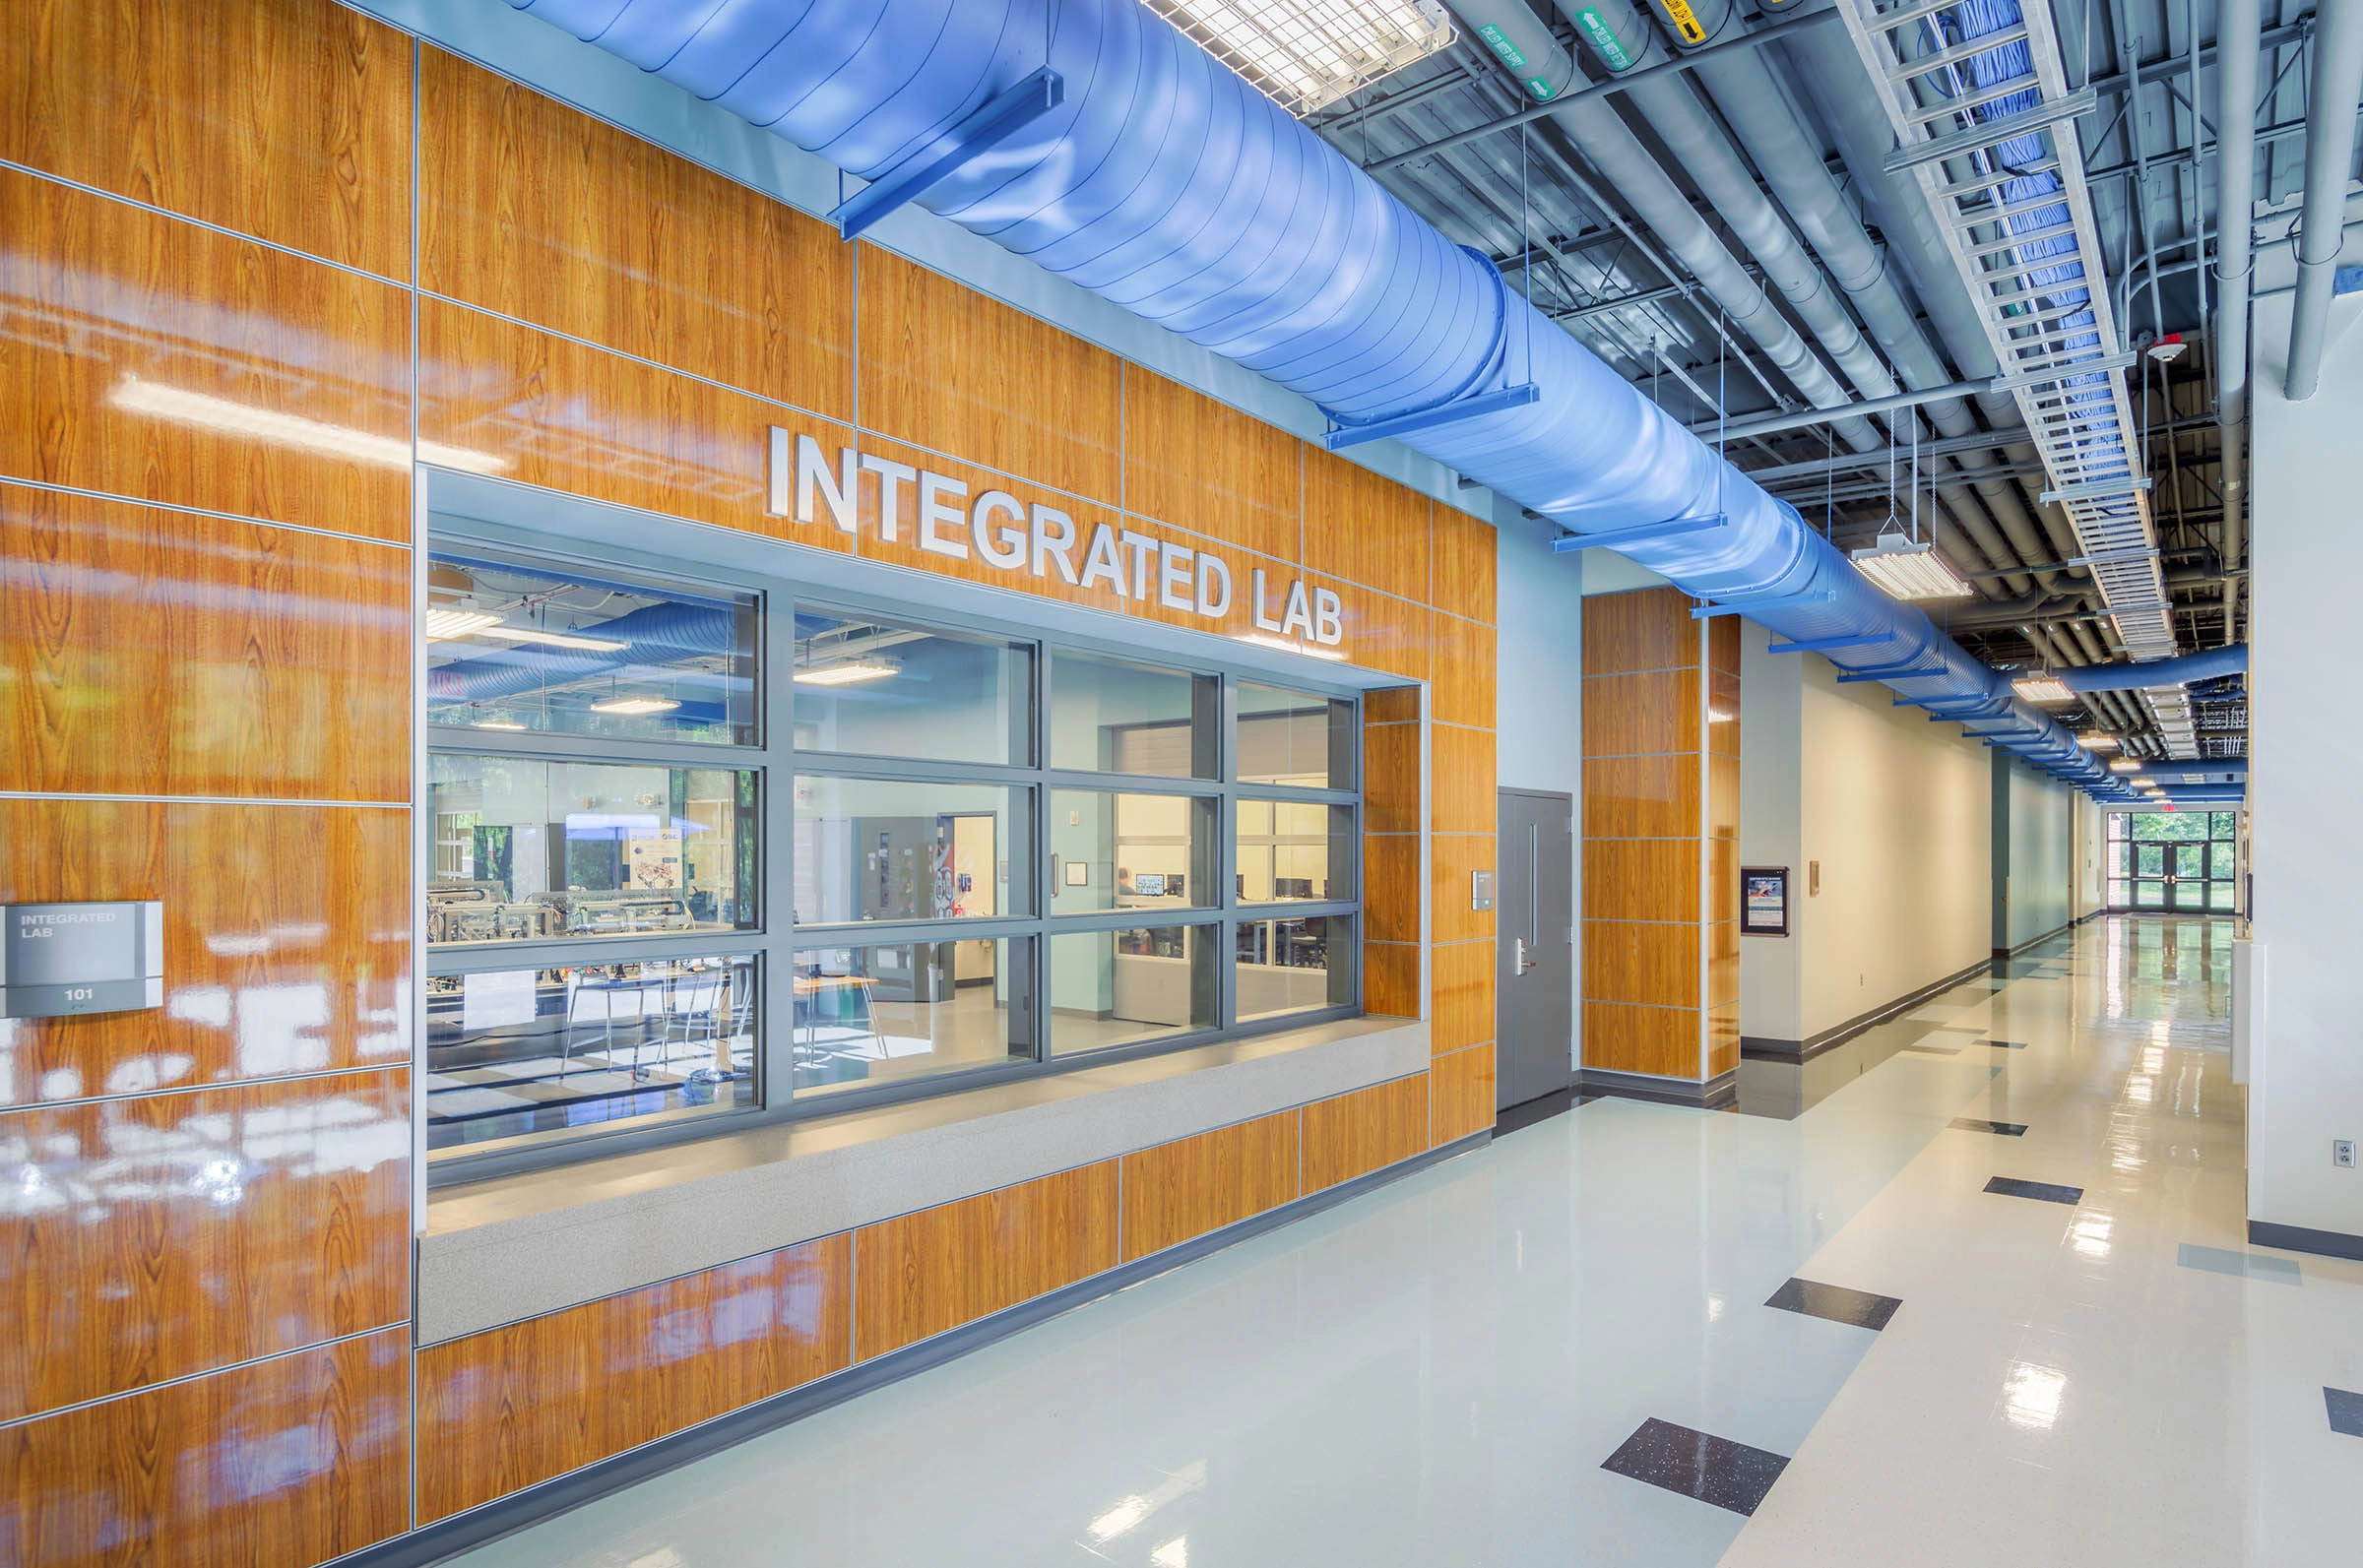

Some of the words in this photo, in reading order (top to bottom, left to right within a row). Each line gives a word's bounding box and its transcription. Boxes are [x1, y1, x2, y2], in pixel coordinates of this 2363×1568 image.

[766, 425, 1232, 618] INTEGRATED
[1252, 568, 1342, 646] LAB
[21, 913, 116, 925] INTEGRATED
[22, 927, 53, 938] LAB
[64, 988, 94, 1001] 101
